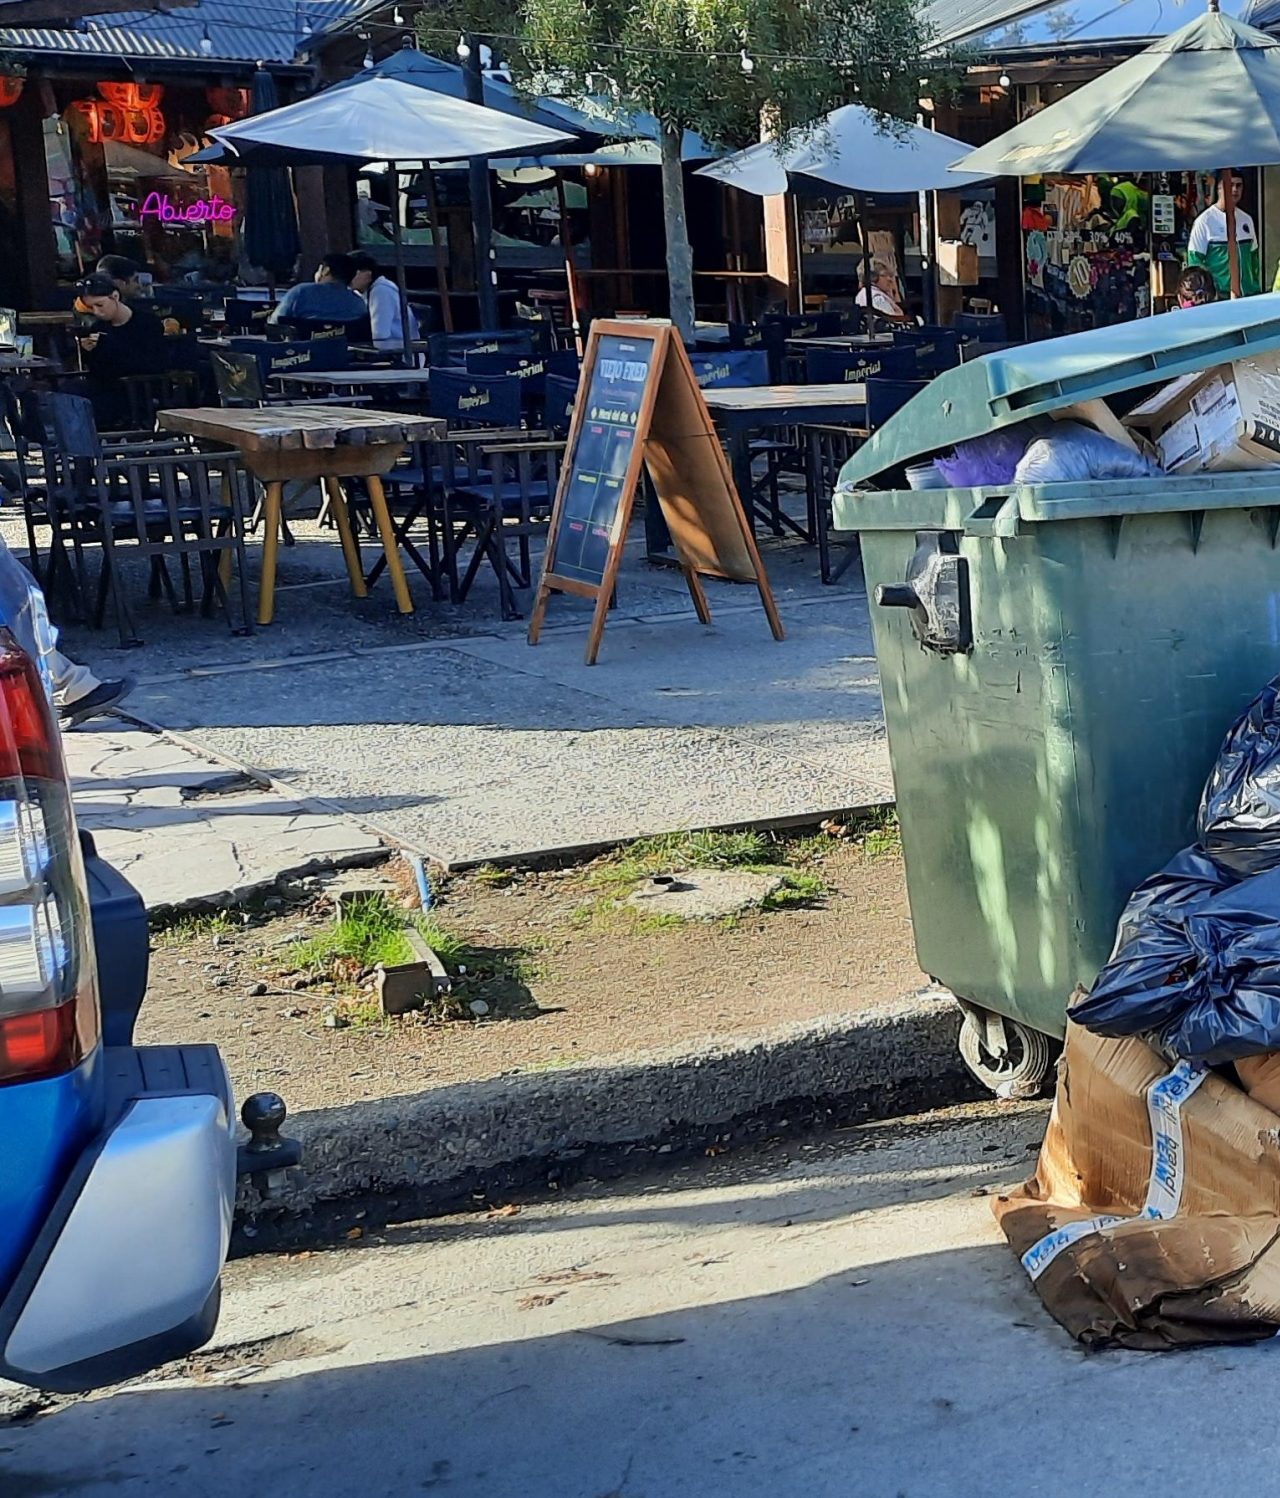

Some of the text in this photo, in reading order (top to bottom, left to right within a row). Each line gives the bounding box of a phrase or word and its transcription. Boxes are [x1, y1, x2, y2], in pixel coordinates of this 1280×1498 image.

[140, 191, 237, 223] Abierto
[1114, 231, 1134, 244] 40%
[845, 360, 882, 382] Imperial
[1165, 1137, 1180, 1192] brand
